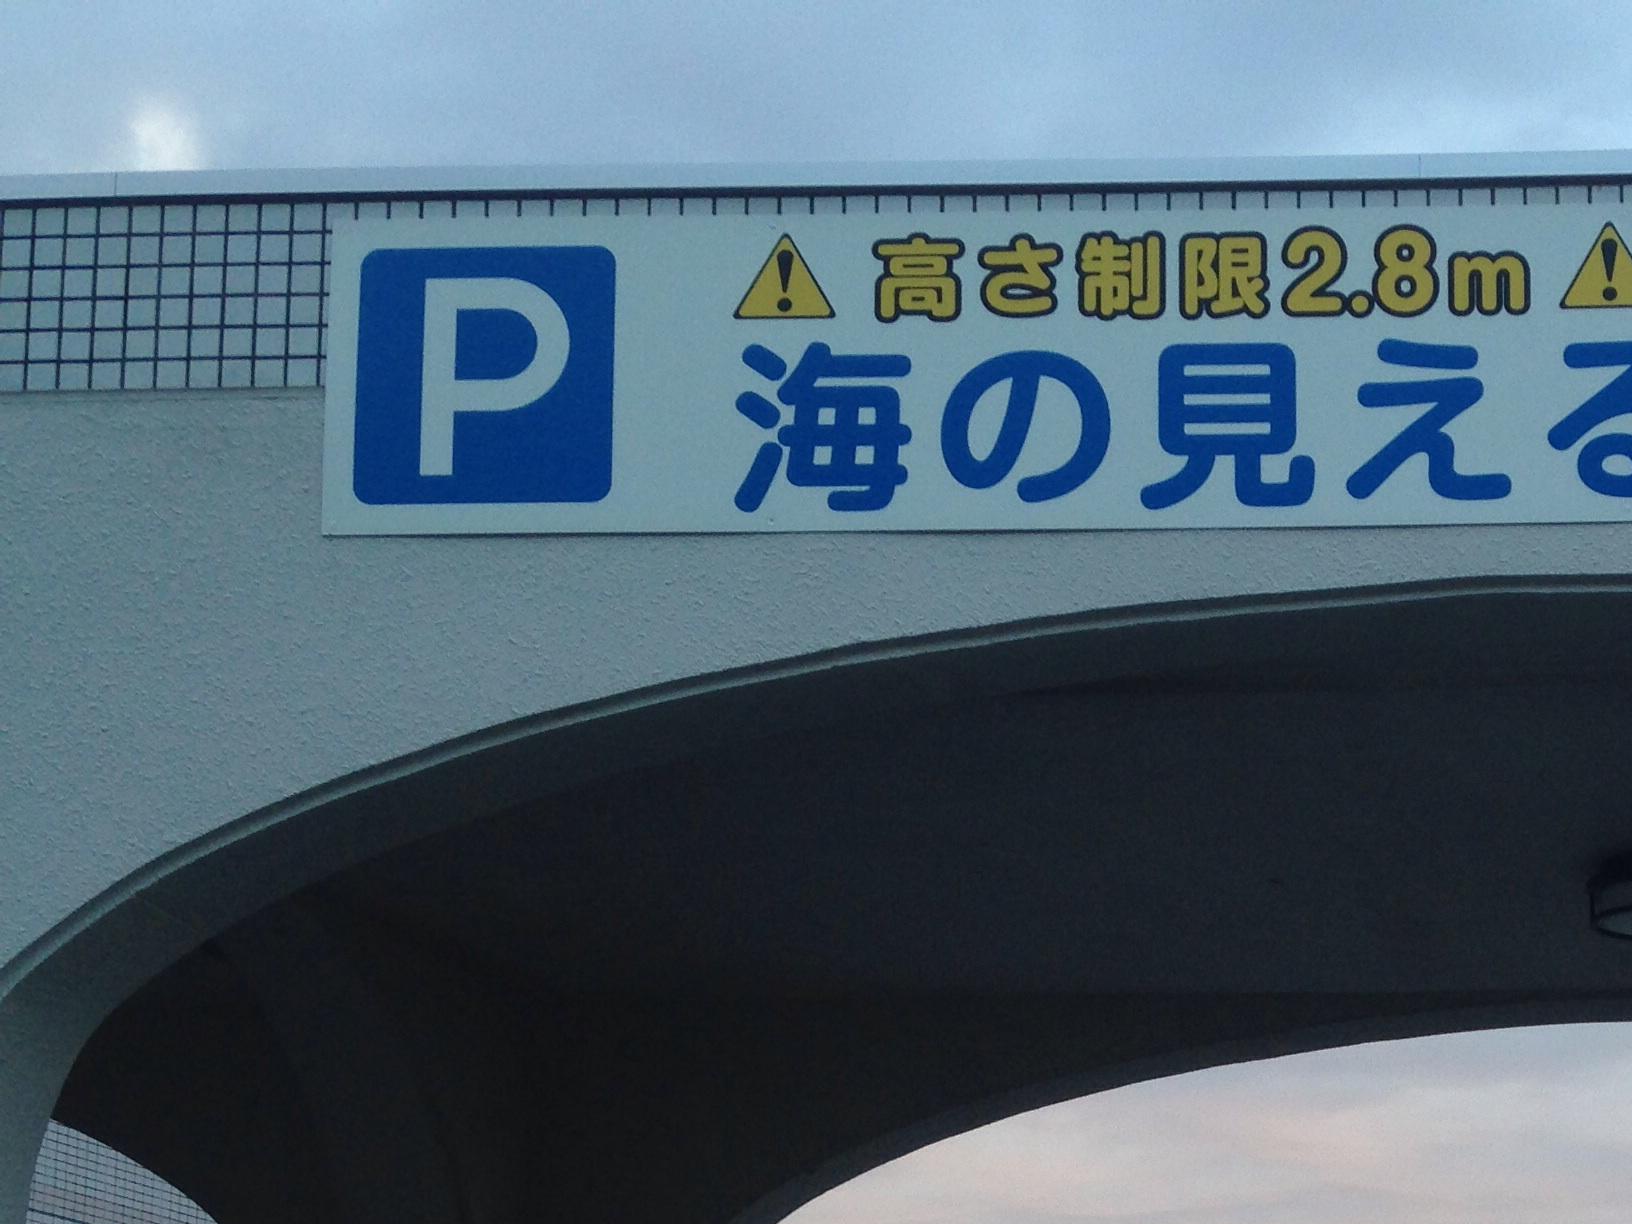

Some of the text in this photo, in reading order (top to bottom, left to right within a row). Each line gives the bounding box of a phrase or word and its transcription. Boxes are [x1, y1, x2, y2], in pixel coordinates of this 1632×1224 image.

[872, 225, 1530, 323] 高さ制限2.8m
[420, 279, 569, 474] P
